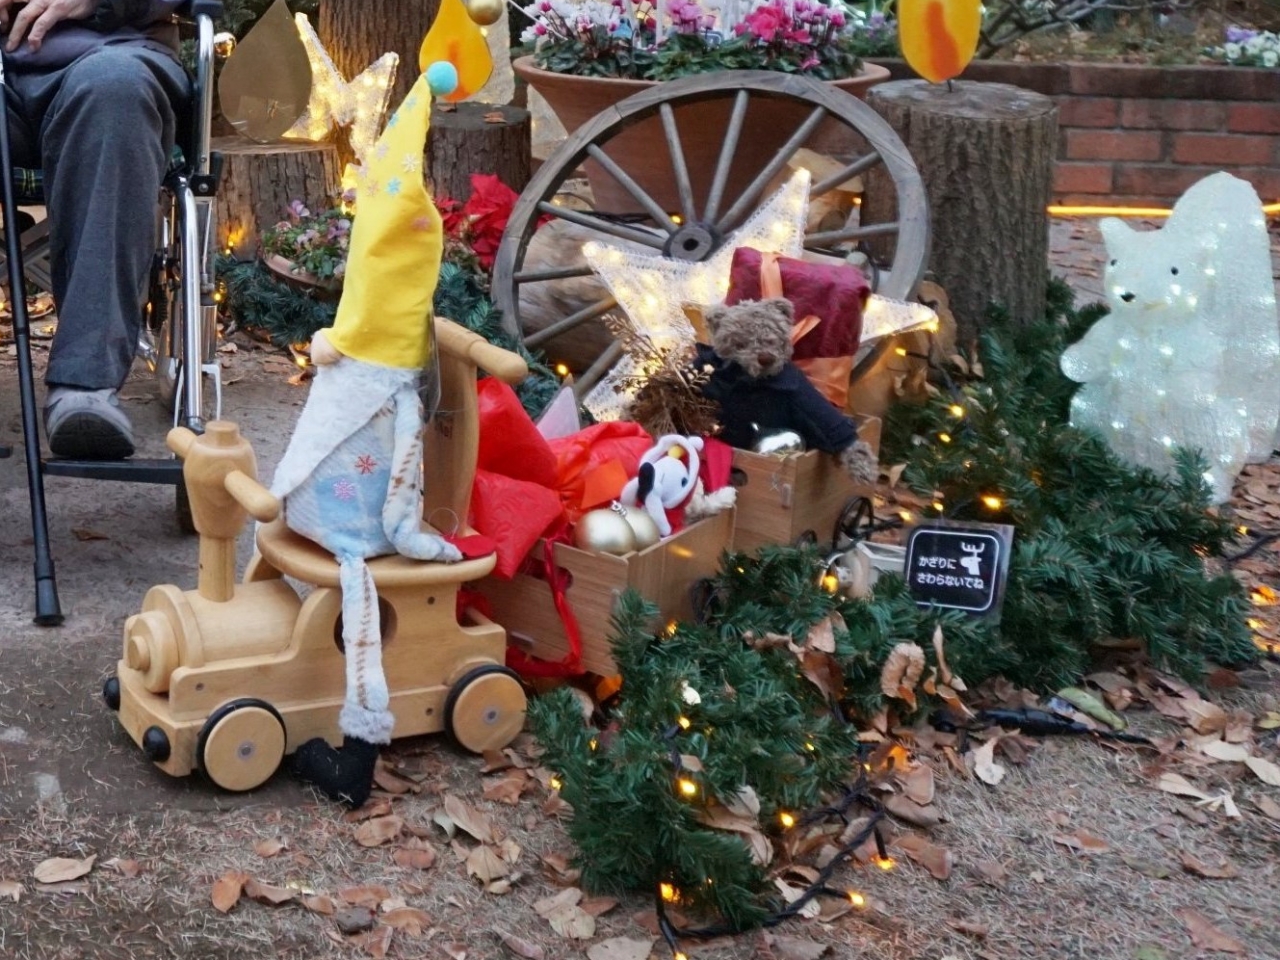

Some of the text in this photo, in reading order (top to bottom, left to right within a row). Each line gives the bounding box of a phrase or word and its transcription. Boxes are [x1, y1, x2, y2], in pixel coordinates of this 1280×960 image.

[918, 556, 957, 570] かざりに
[917, 572, 984, 589] さわらないでね
